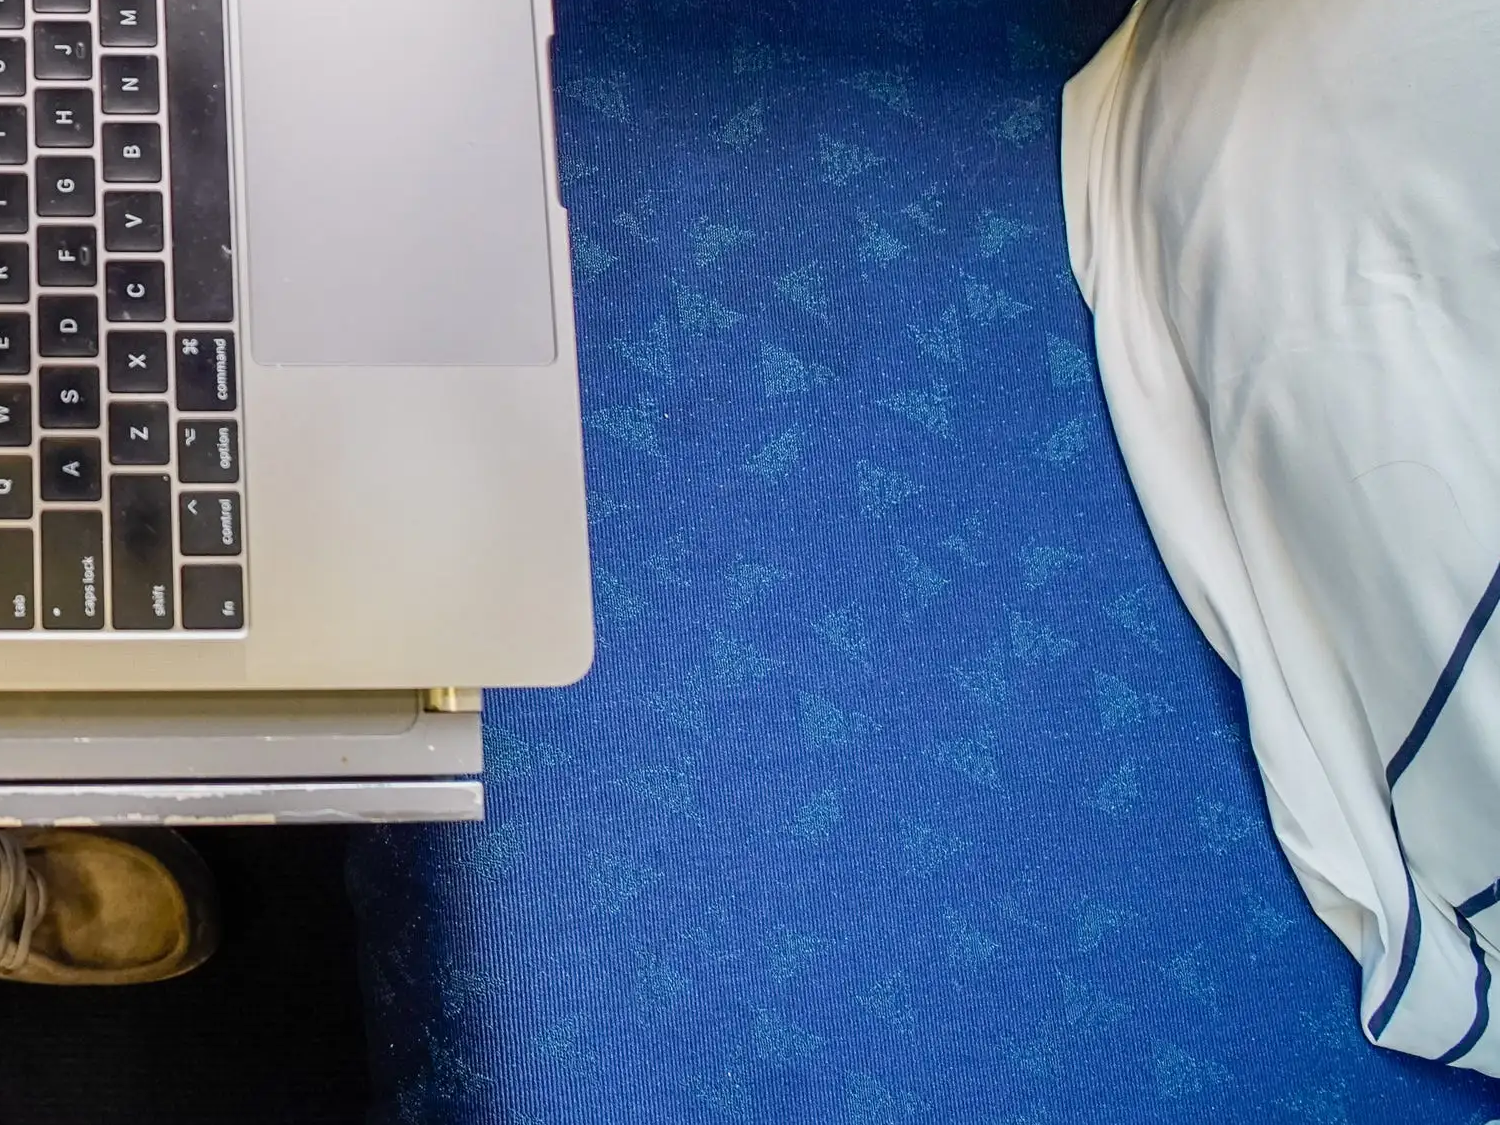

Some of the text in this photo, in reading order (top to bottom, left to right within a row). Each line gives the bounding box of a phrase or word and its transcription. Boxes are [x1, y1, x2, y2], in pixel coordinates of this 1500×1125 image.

[120, 10, 137, 25] M
[54, 45, 72, 55] J
[122, 78, 139, 91] N
[56, 111, 73, 124] H
[123, 145, 141, 158] B
[57, 179, 75, 193] G
[125, 214, 142, 228] V
[58, 250, 76, 261] F
[127, 284, 145, 297] C
[60, 319, 78, 333] D
[128, 354, 146, 368] X
[213, 338, 228, 400] command
[60, 389, 79, 403] S
[130, 427, 148, 440] Z
[217, 427, 232, 469] option
[62, 461, 80, 476] A
[219, 499, 233, 545] control
[82, 556, 97, 616] caps lock
[13, 595, 25, 617] tab
[152, 585, 166, 616] shift
[222, 601, 234, 616] fn
